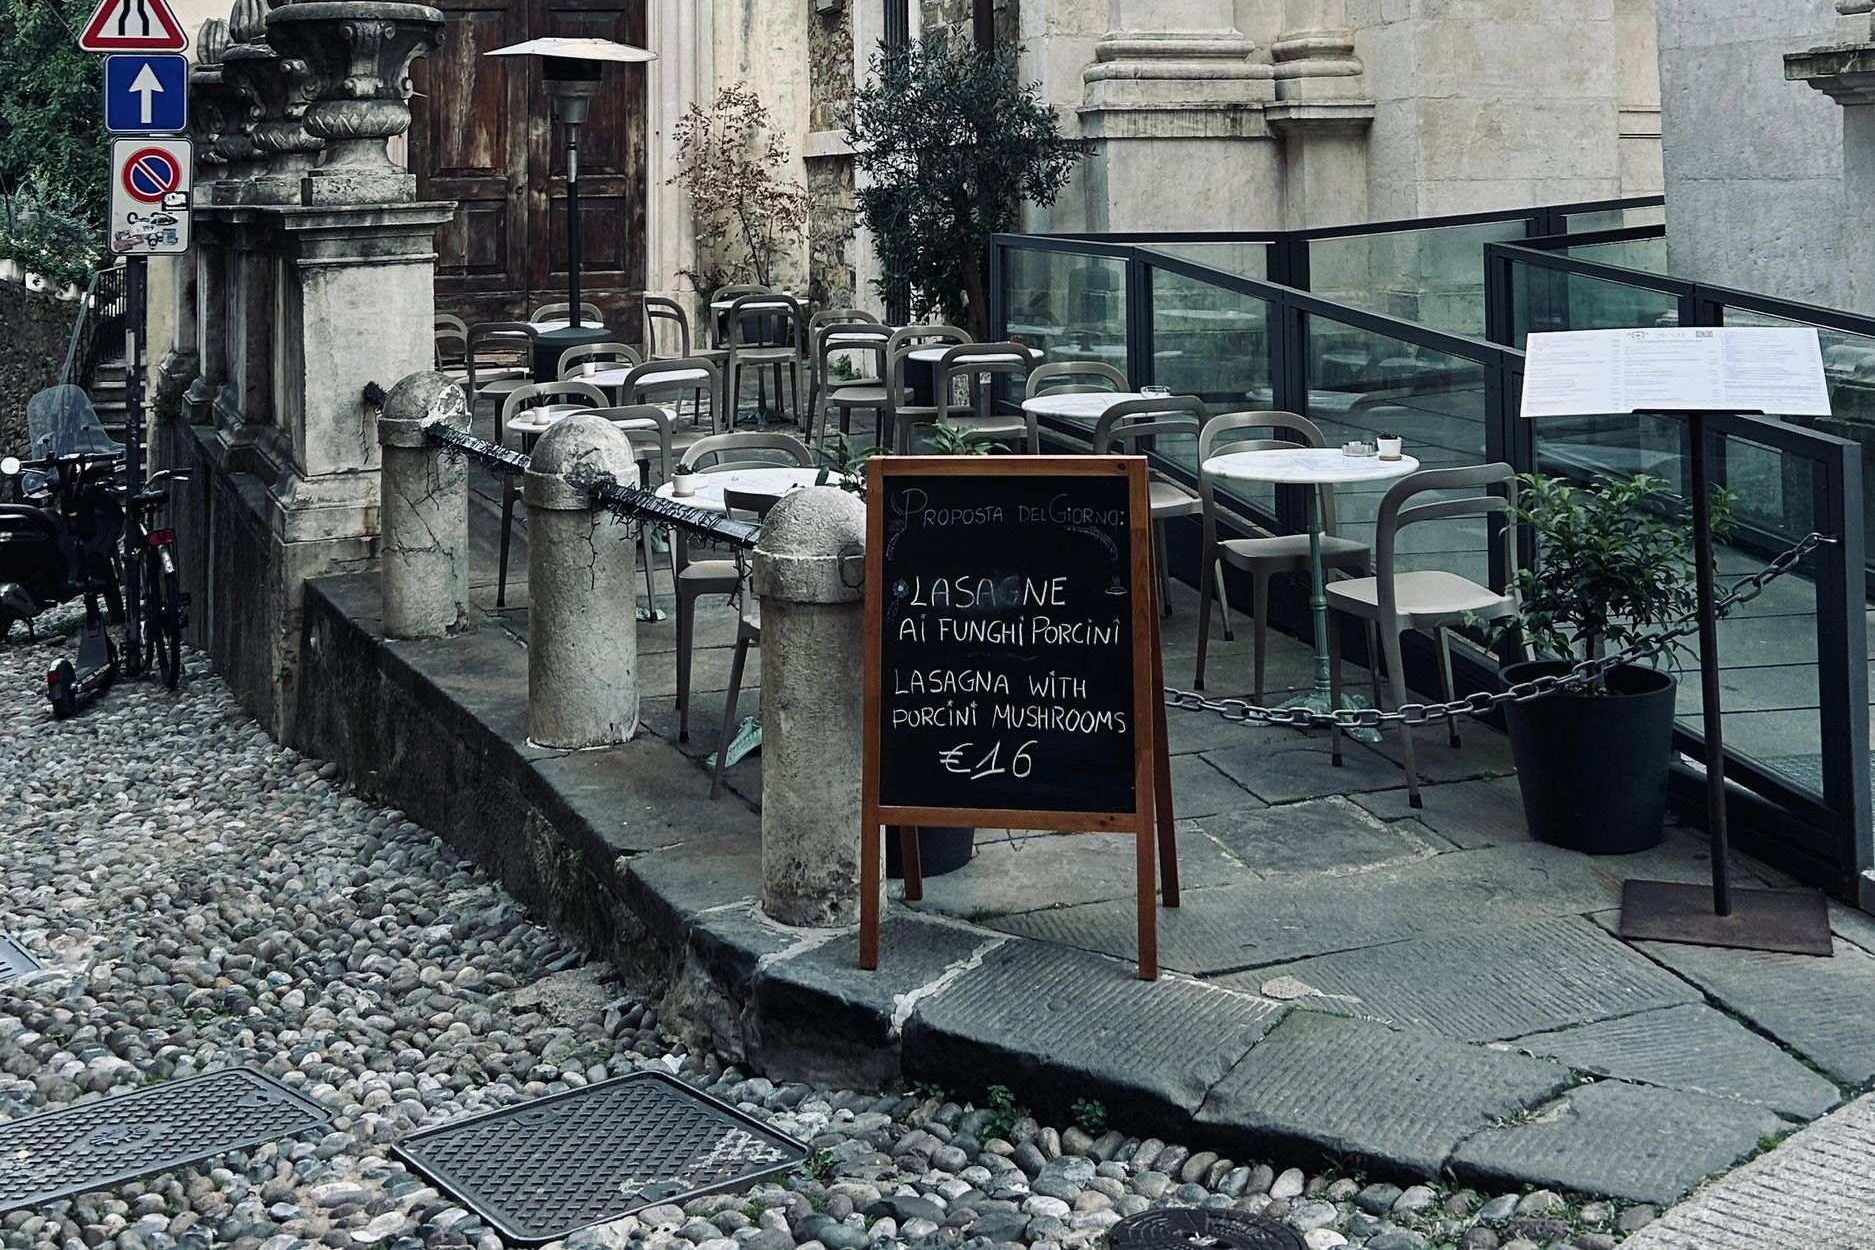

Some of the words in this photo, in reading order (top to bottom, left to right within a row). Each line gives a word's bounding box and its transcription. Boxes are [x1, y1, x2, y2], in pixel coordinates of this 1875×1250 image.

[1018, 504, 1047, 523] DEL
[911, 575, 1067, 608] LASAGNE
[894, 669, 1010, 695] LASAGNA
[992, 704, 1127, 734] MUSHROOMS
[938, 740, 1038, 780] €16
